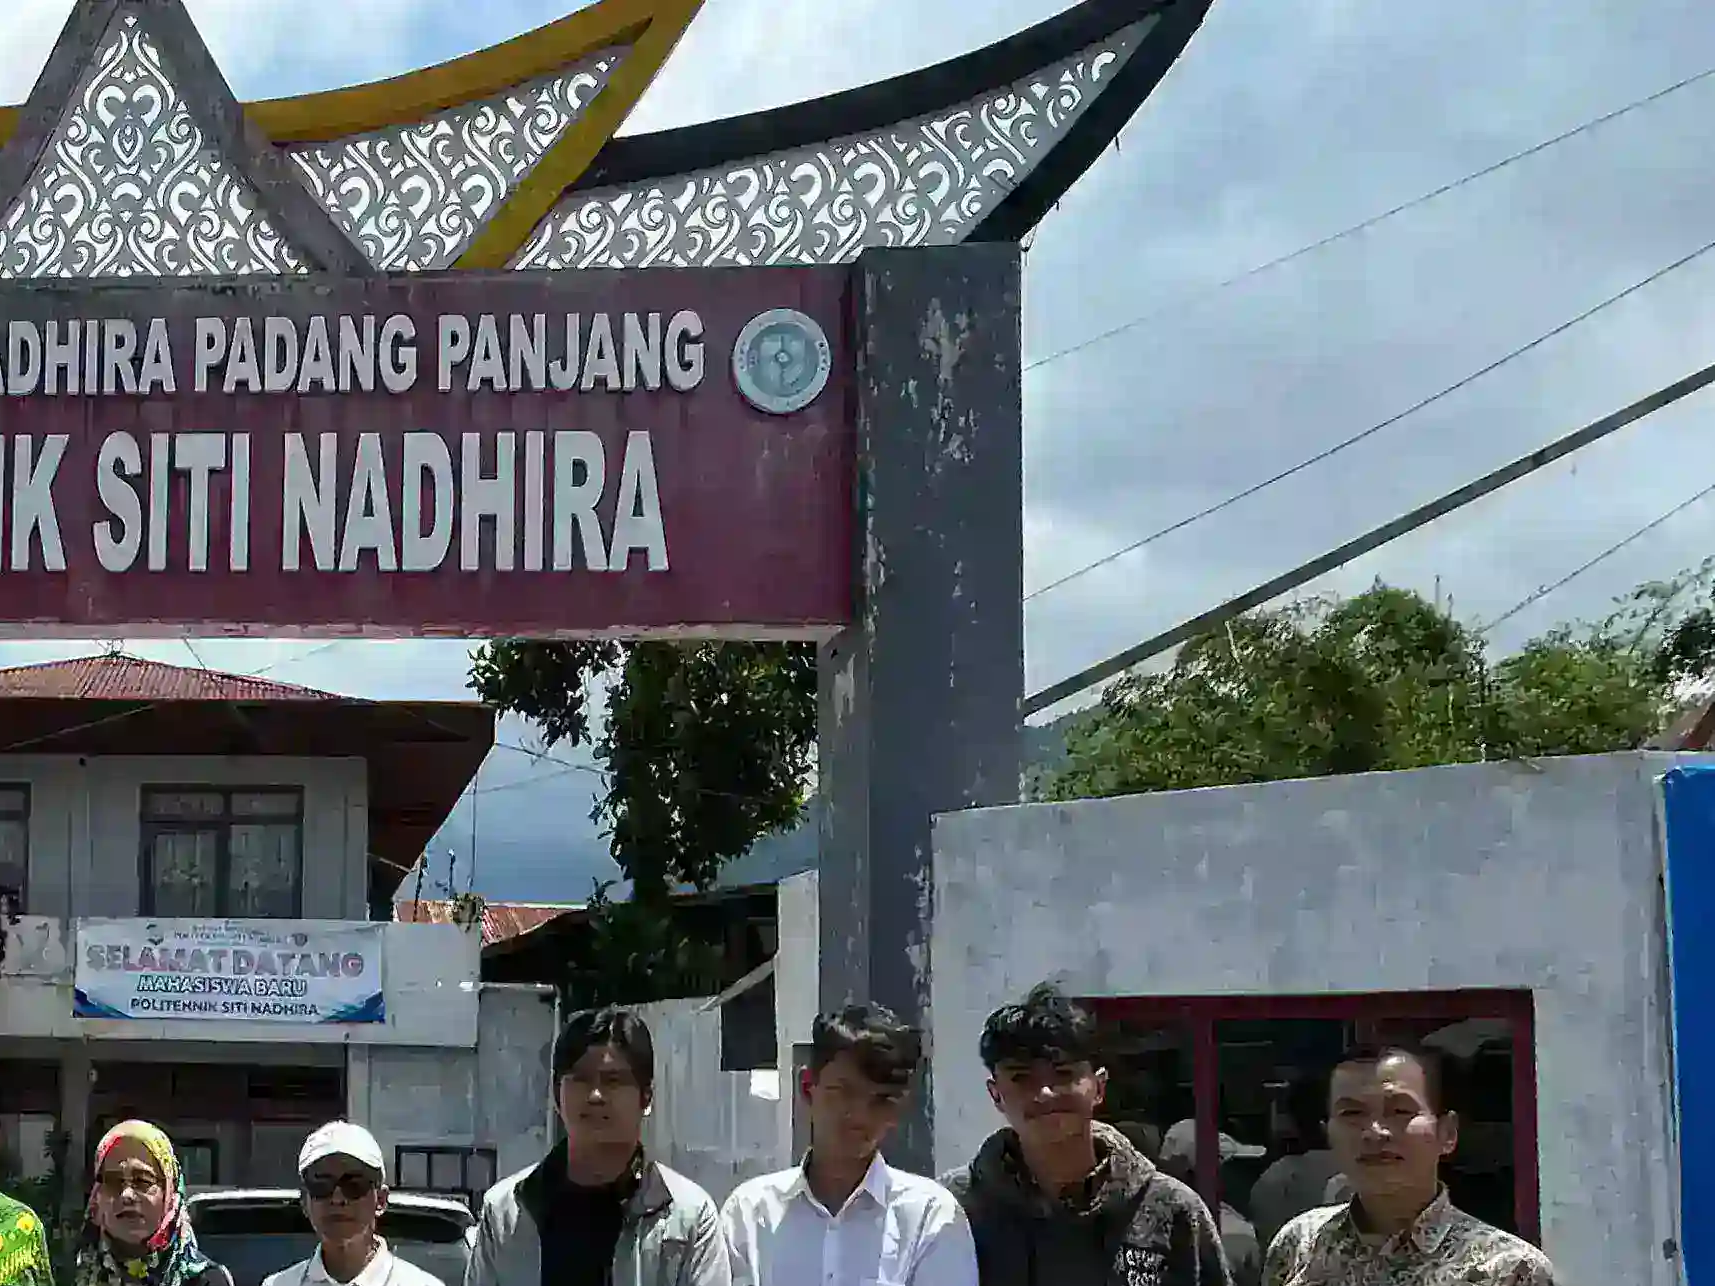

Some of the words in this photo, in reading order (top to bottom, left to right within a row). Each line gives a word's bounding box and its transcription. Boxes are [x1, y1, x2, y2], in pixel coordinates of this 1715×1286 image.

[194, 313, 418, 394] PADANG
[437, 309, 705, 394] PANJANG
[92, 430, 252, 574] SITI
[282, 430, 670, 573] NADHIRA
[86, 945, 229, 974] SELAMAT
[232, 949, 365, 979] DATANG
[137, 975, 252, 996] MAHASISWA
[253, 976, 308, 998] BARU
[130, 997, 218, 1014] POLITEKNIK
[221, 1001, 249, 1015] SITI
[251, 1003, 320, 1016] NADHIRA
